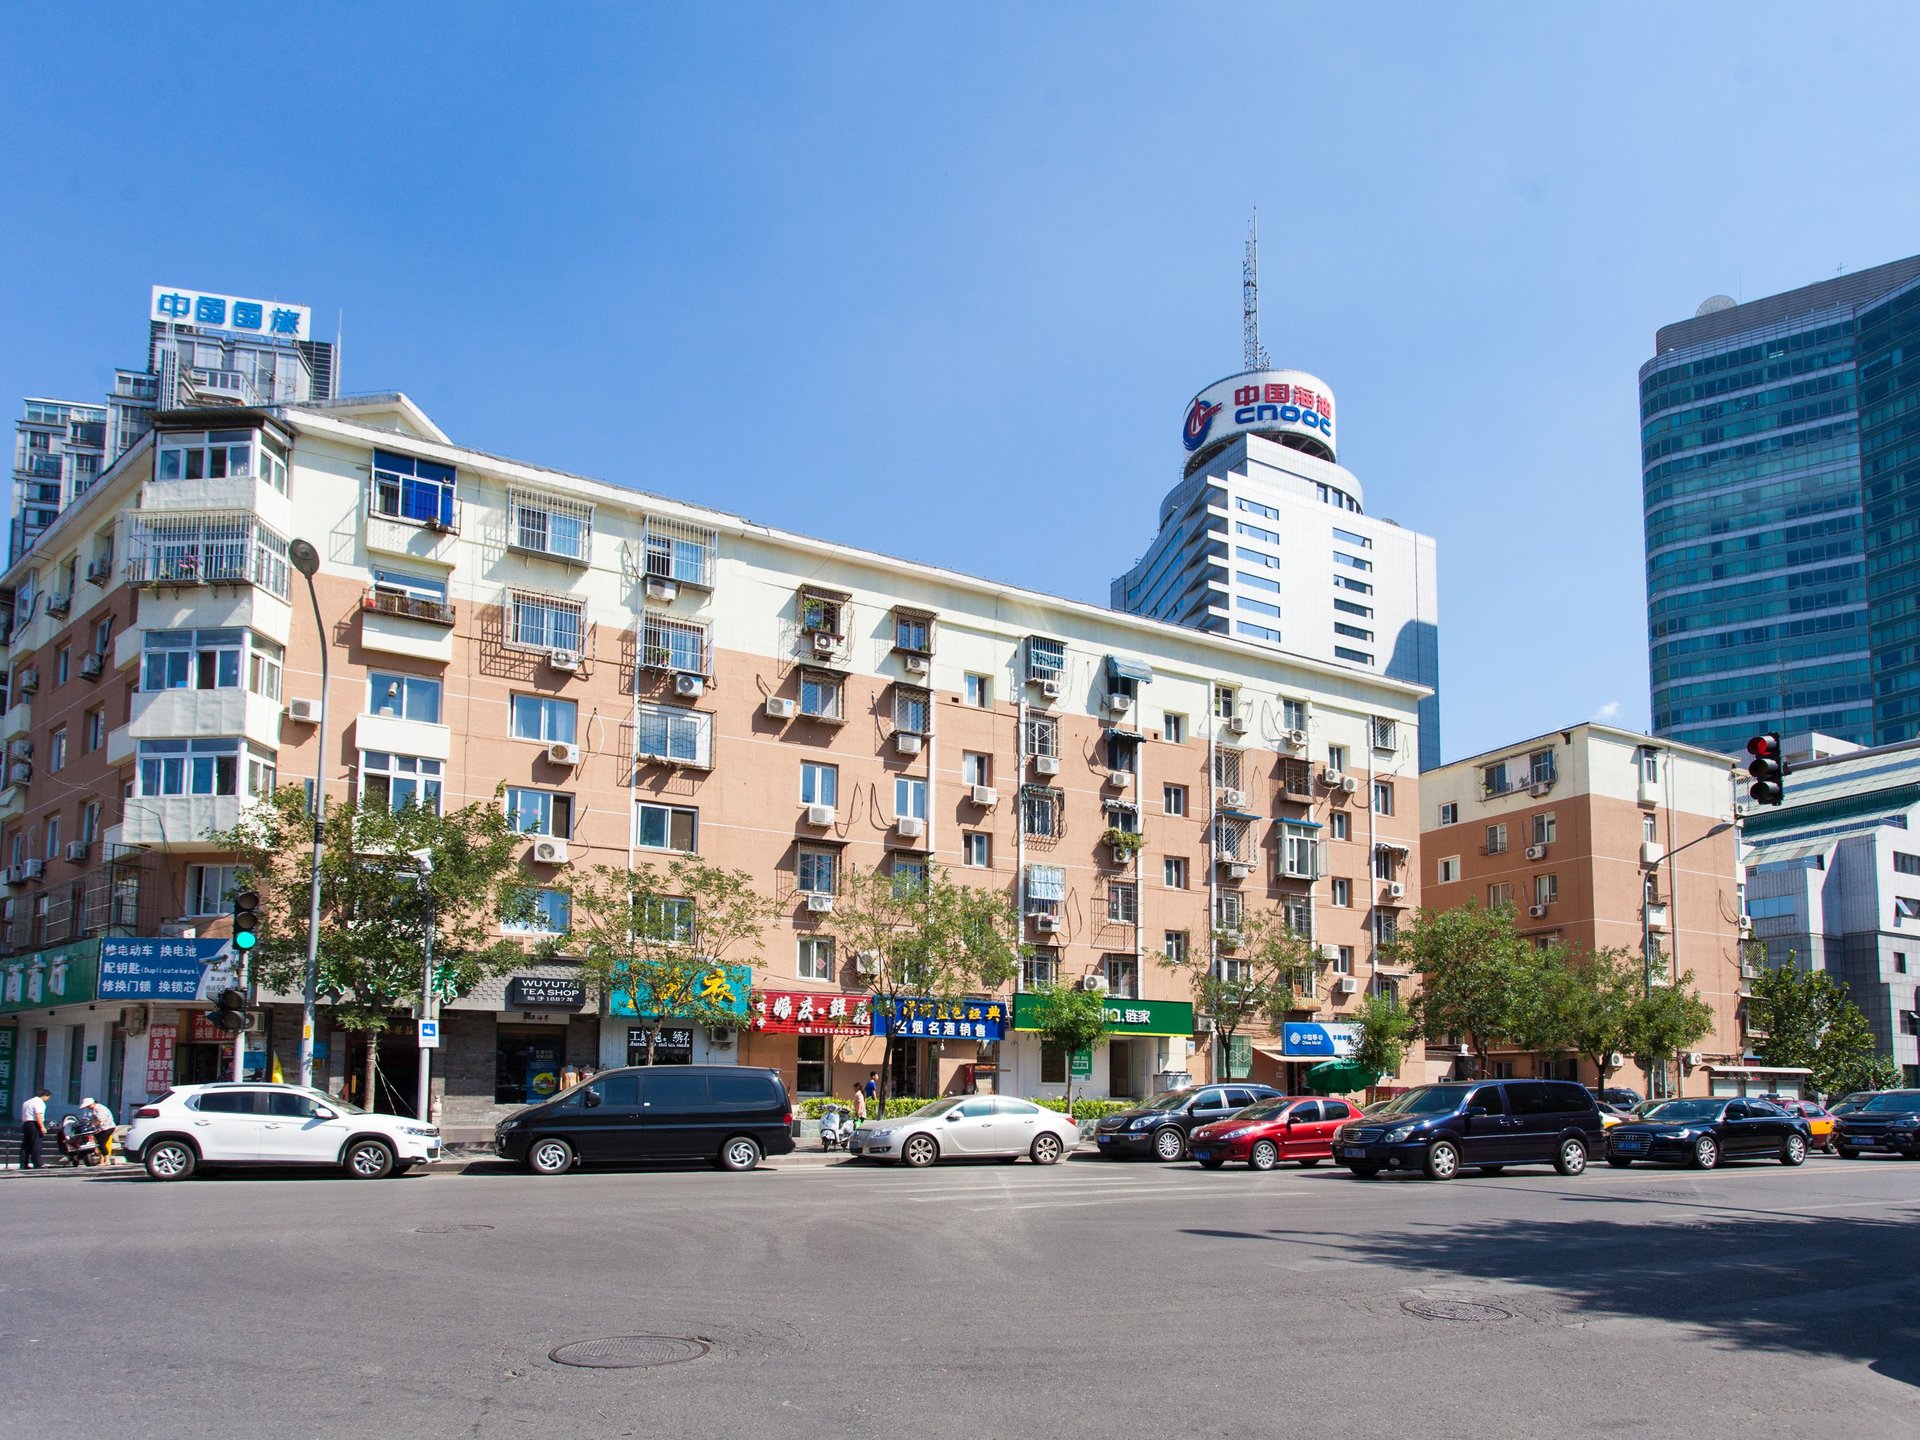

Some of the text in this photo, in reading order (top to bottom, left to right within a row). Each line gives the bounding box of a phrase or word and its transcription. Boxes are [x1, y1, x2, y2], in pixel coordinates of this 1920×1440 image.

[159, 293, 301, 334] 中国国旅
[1234, 383, 1332, 419] 中国海油
[105, 944, 197, 957] 修电动车 换电池
[104, 962, 140, 974] 配钥匙
[102, 981, 151, 993] 修换门锁
[158, 981, 196, 993] 换锁芯
[521, 988, 580, 997] TEA SHOP
[896, 1020, 986, 1038] 名烟名酒销售
